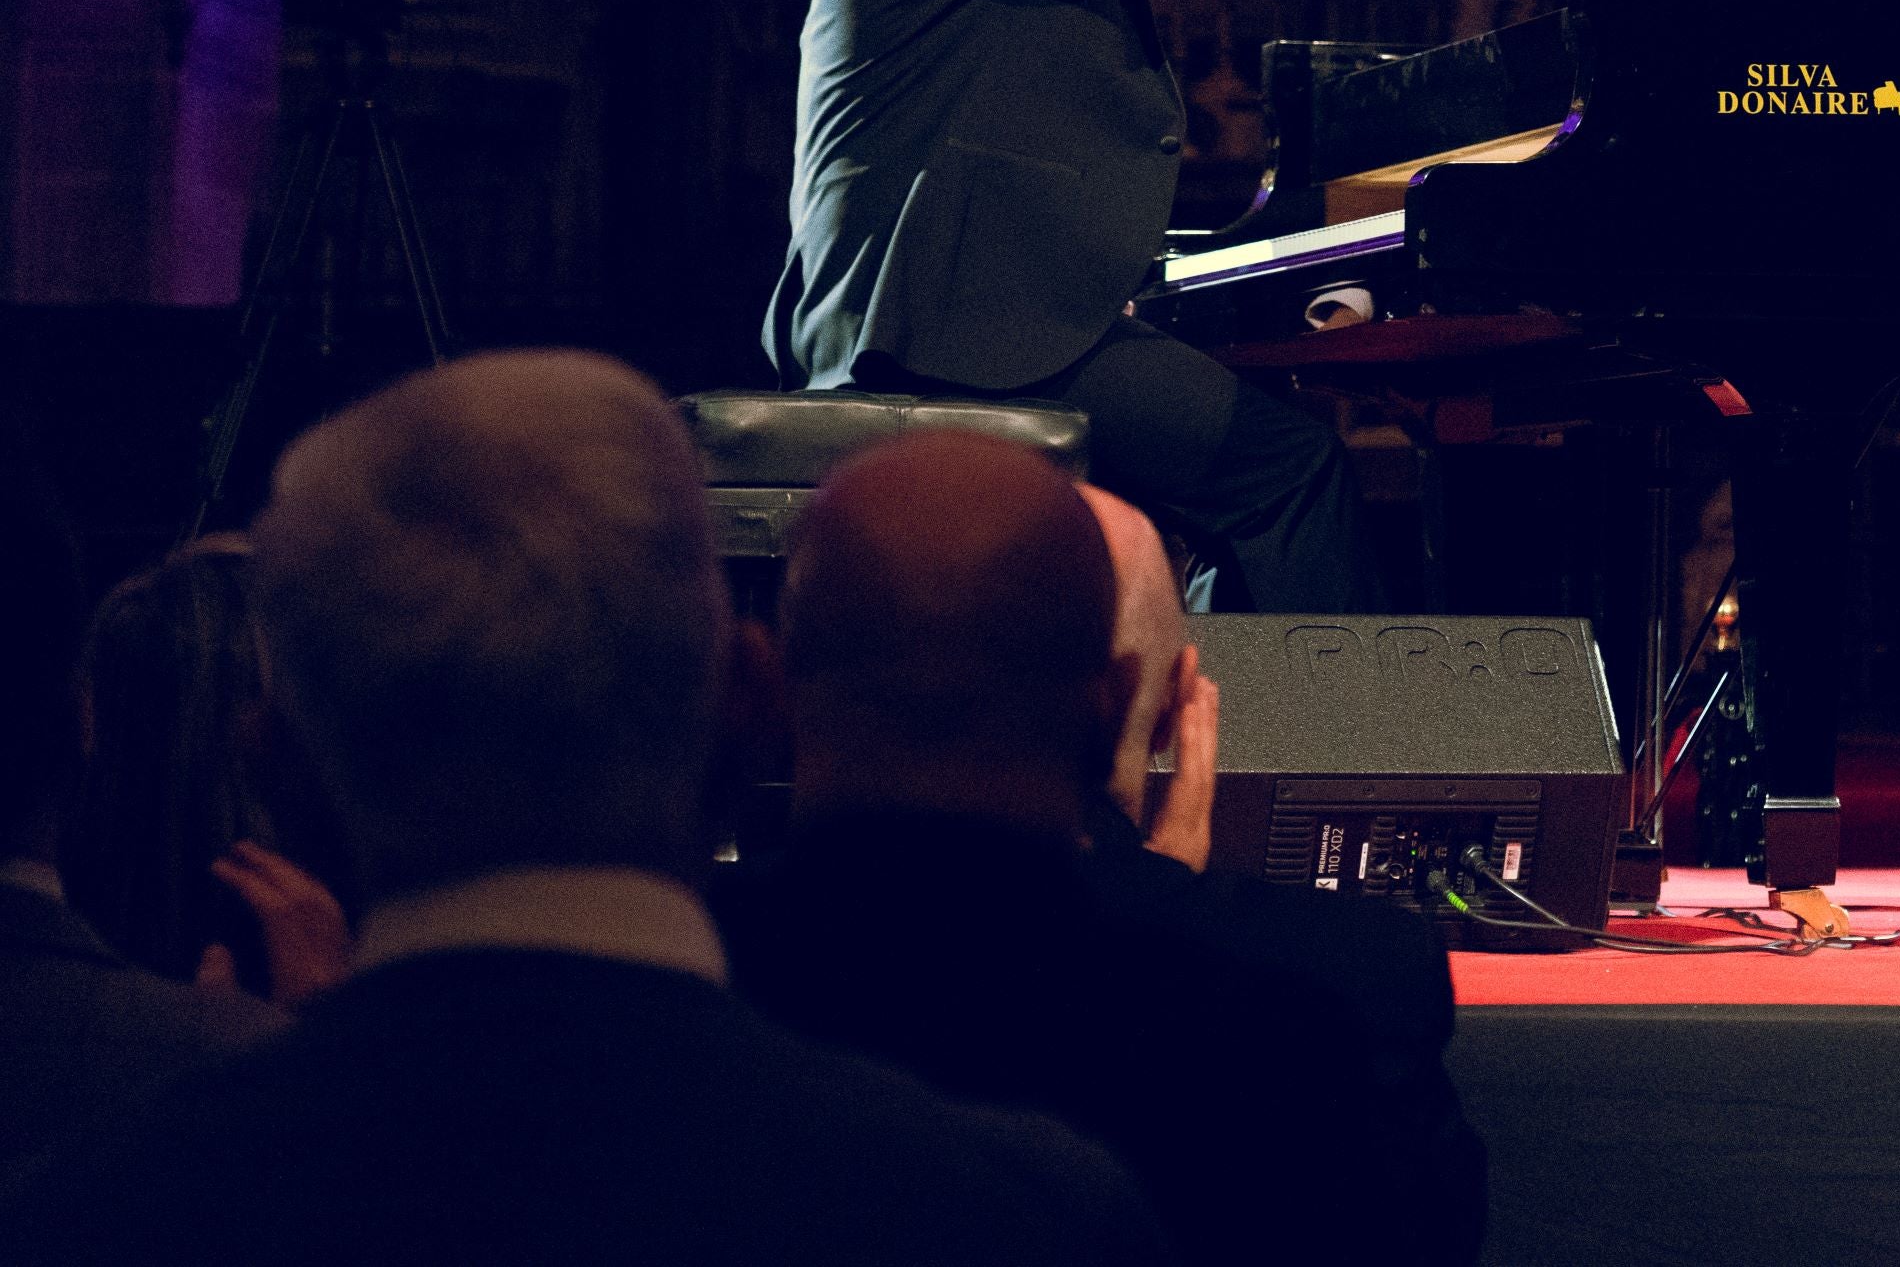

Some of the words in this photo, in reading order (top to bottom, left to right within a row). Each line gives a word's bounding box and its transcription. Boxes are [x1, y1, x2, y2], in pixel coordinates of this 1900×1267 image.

[1747, 63, 1838, 88] SILVA
[1717, 90, 1869, 115] DONAIRE
[1329, 828, 1344, 853] XD2
[1318, 841, 1328, 873] PREMIUM
[1327, 855, 1340, 874] 110
